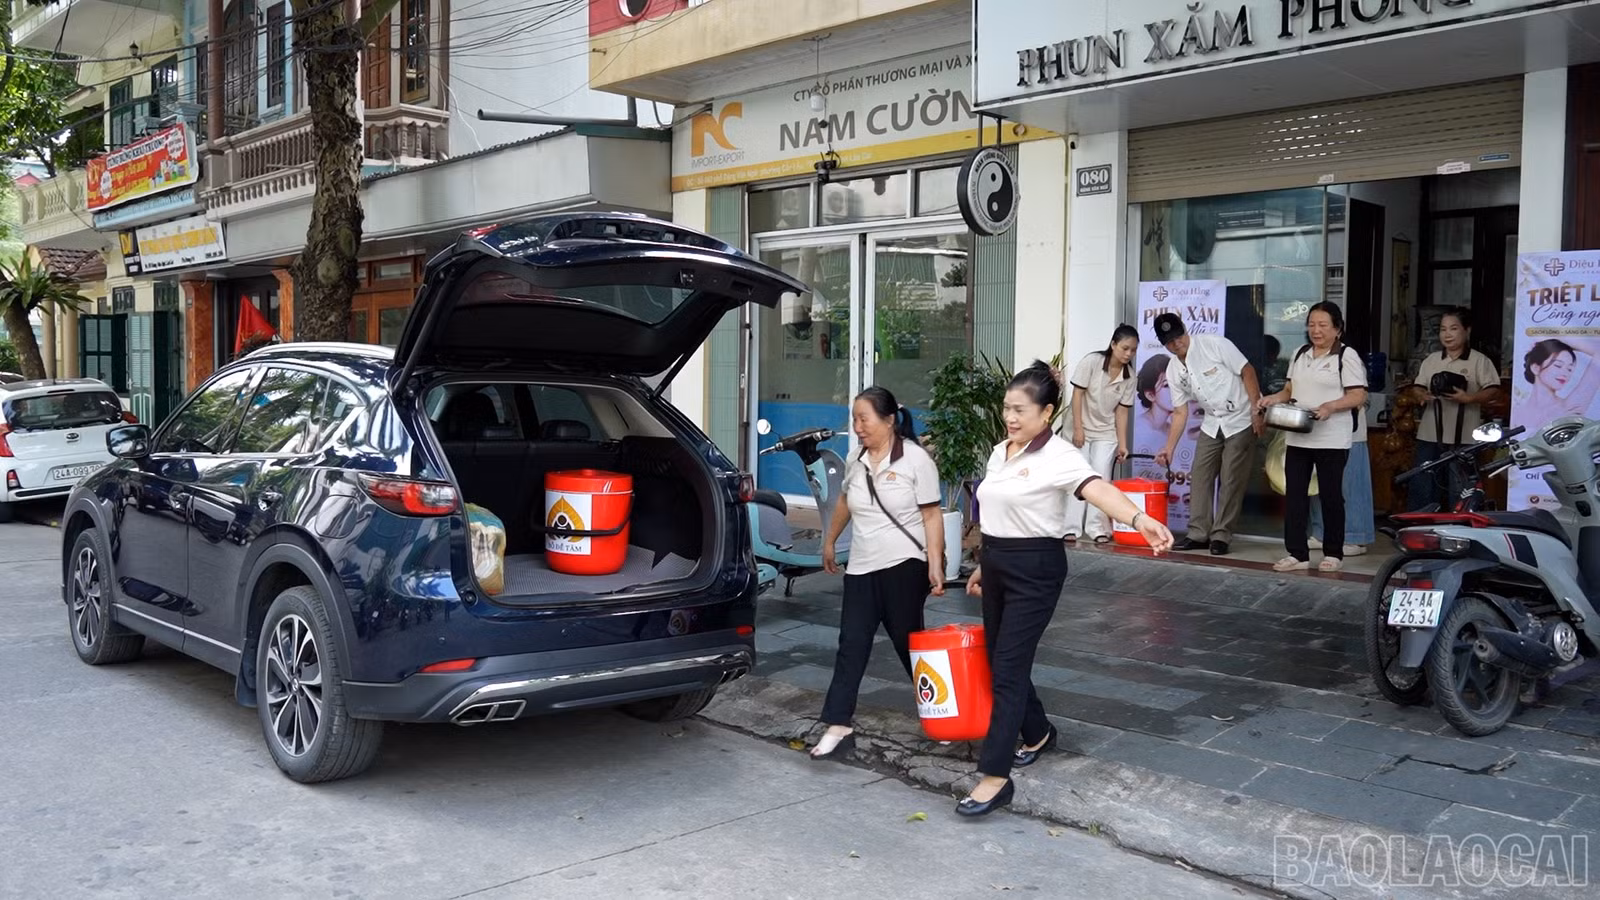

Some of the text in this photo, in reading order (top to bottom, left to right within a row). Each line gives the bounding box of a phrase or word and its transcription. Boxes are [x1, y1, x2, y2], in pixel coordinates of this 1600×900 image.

[1017, 29, 1126, 87] PHUN
[1144, 1, 1255, 64] XĂM
[865, 66, 917, 87] THƯƠNG
[919, 60, 943, 77] MẠI
[946, 55, 962, 70] VÀ
[780, 110, 856, 152] NAM
[1080, 169, 1109, 186] 080
[1569, 259, 1595, 271] Diệu
[1527, 281, 1586, 307] TRIỆT
[1187, 302, 1219, 325] XĂM
[1531, 303, 1576, 327] Công
[1400, 592, 1433, 607] 24-AA
[1393, 608, 1434, 625] 226.34
